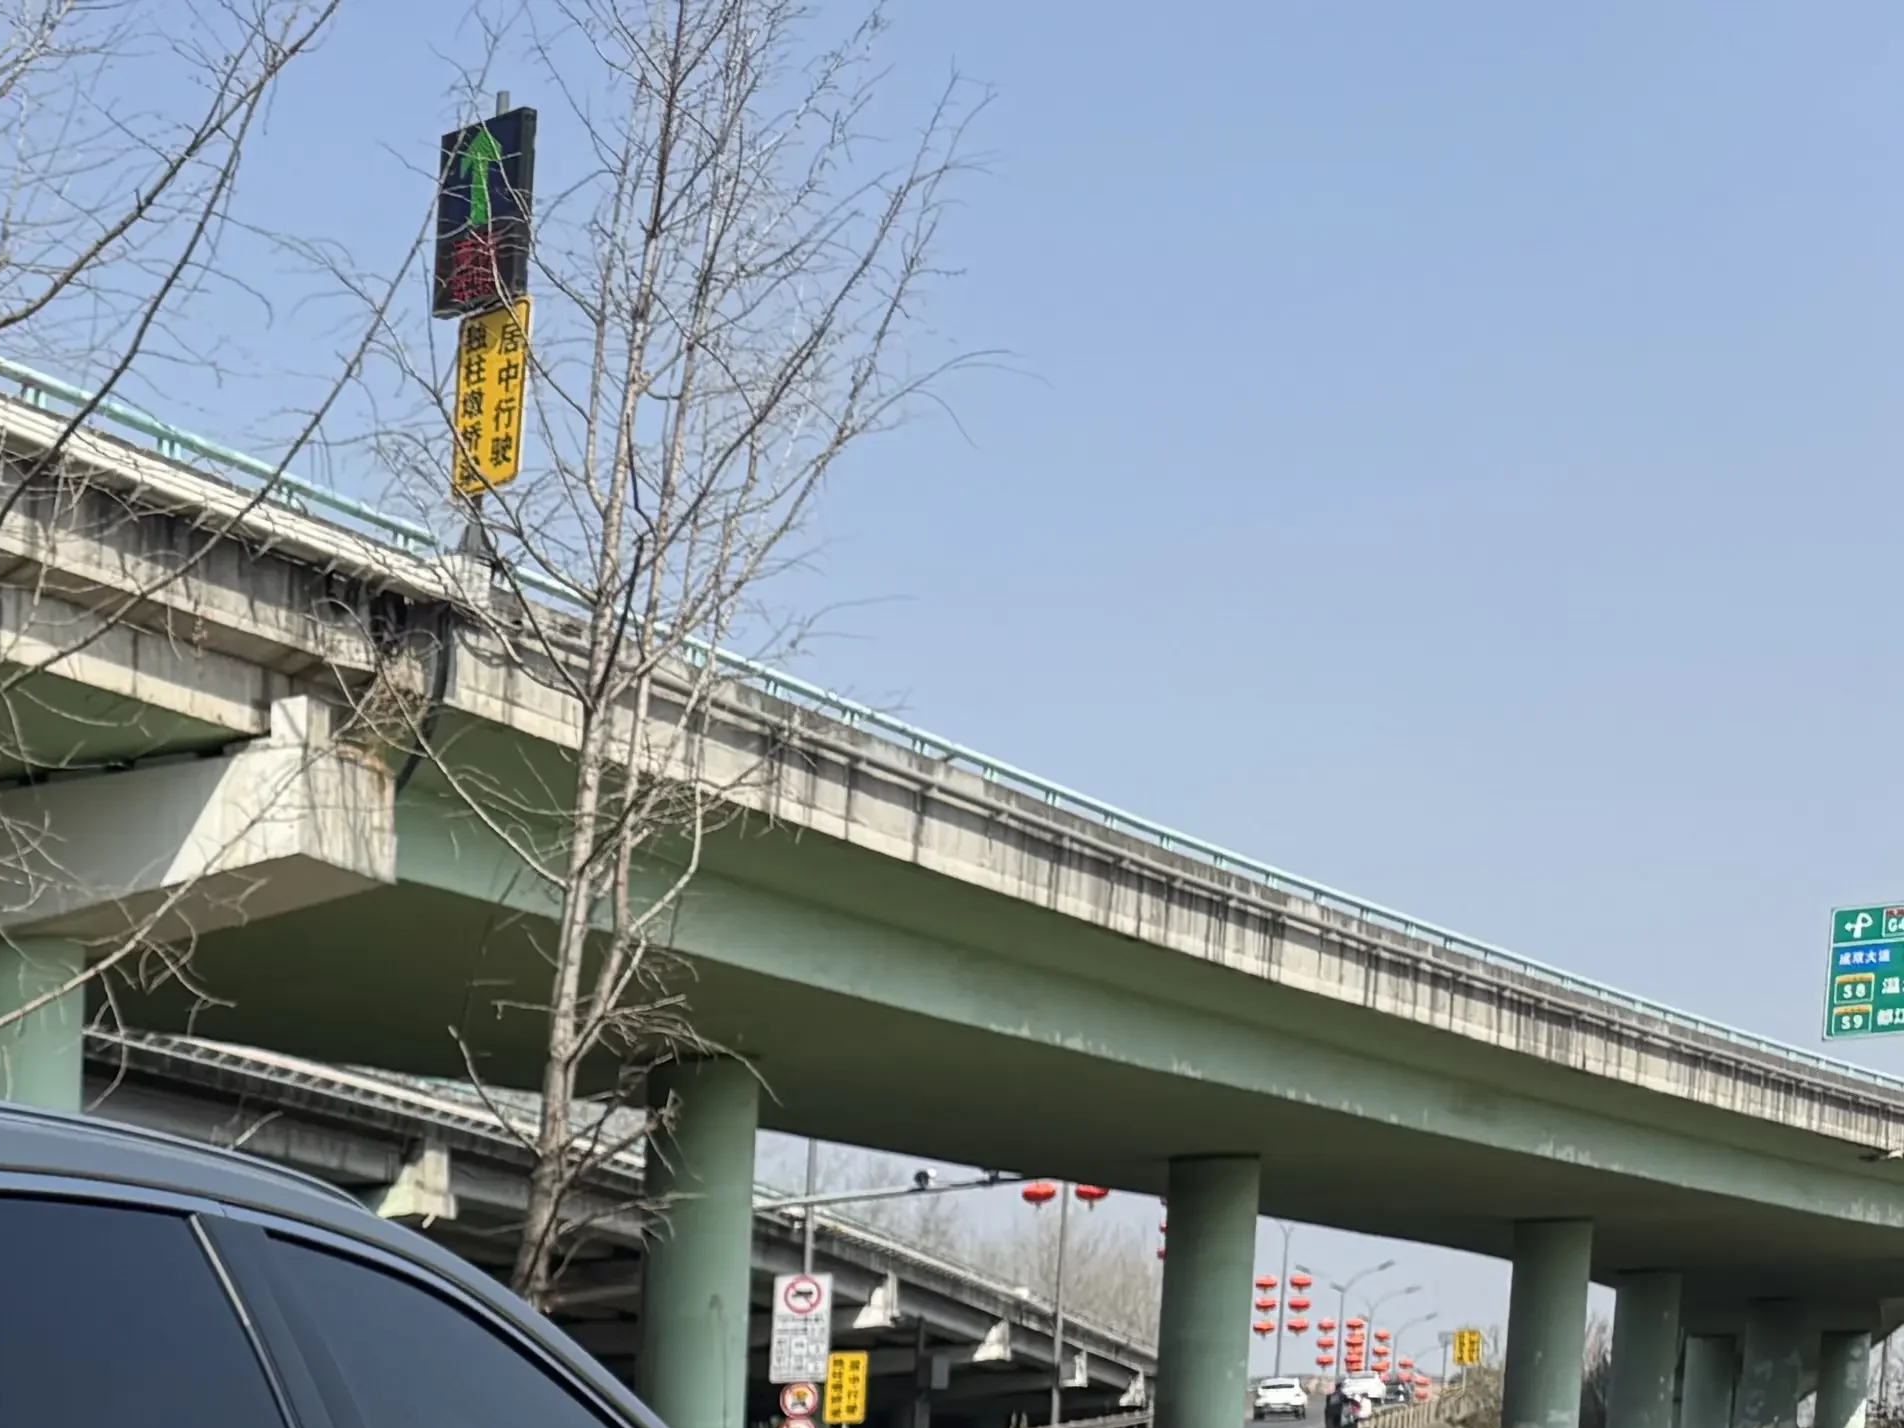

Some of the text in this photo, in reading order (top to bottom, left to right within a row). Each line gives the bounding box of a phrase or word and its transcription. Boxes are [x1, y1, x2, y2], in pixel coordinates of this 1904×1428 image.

[490, 322, 522, 467] 居中行驶
[1843, 983, 1866, 999] S8
[1881, 976, 1904, 995] 温
[1841, 1014, 1863, 1030] S9
